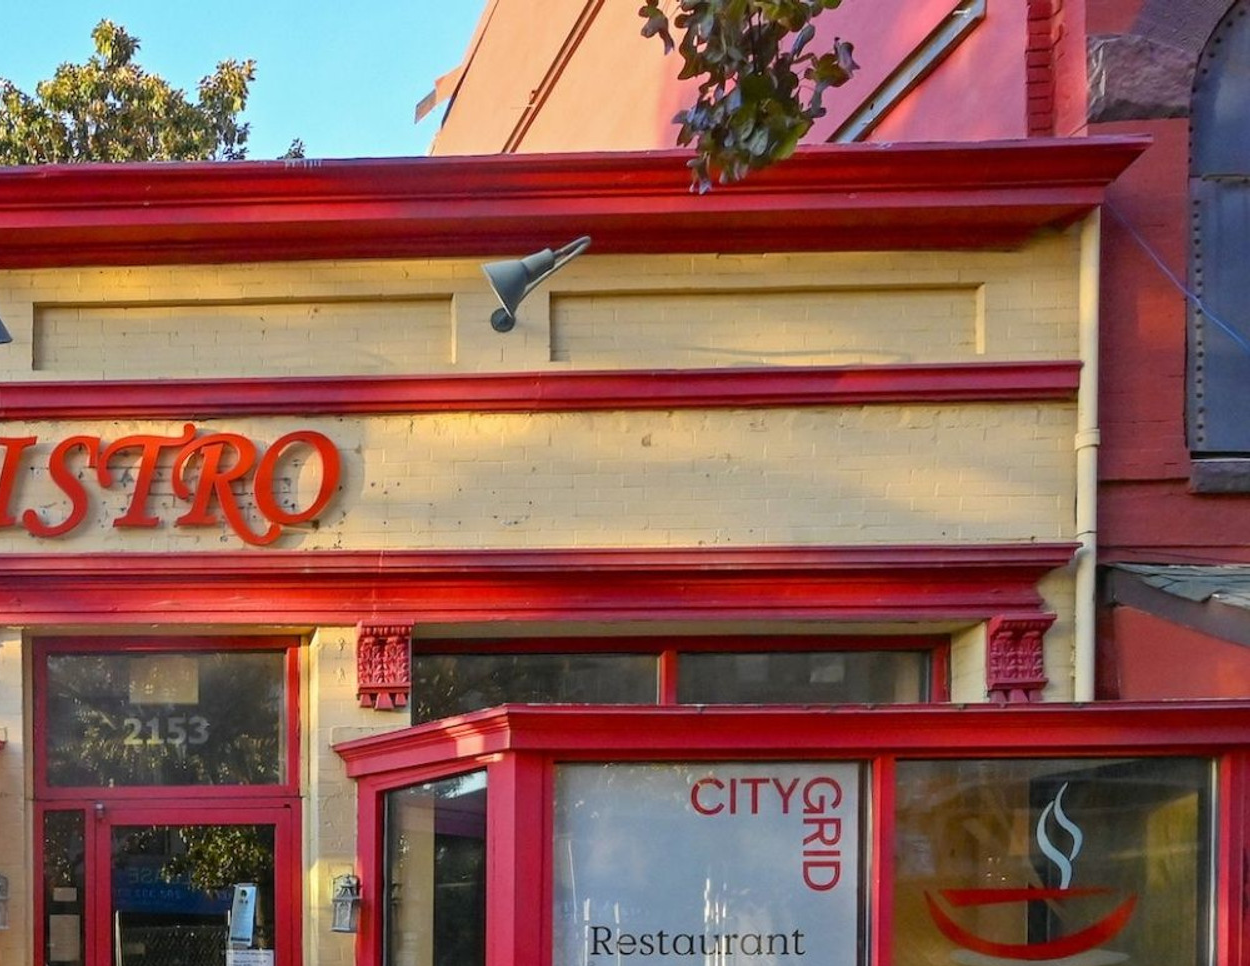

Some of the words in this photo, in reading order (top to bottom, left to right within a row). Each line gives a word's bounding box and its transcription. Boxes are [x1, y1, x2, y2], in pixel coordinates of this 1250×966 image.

[123, 716, 211, 745] 2153
[690, 778, 800, 816] CITY
[802, 776, 843, 892] GRID
[590, 926, 806, 956] Restaurant
